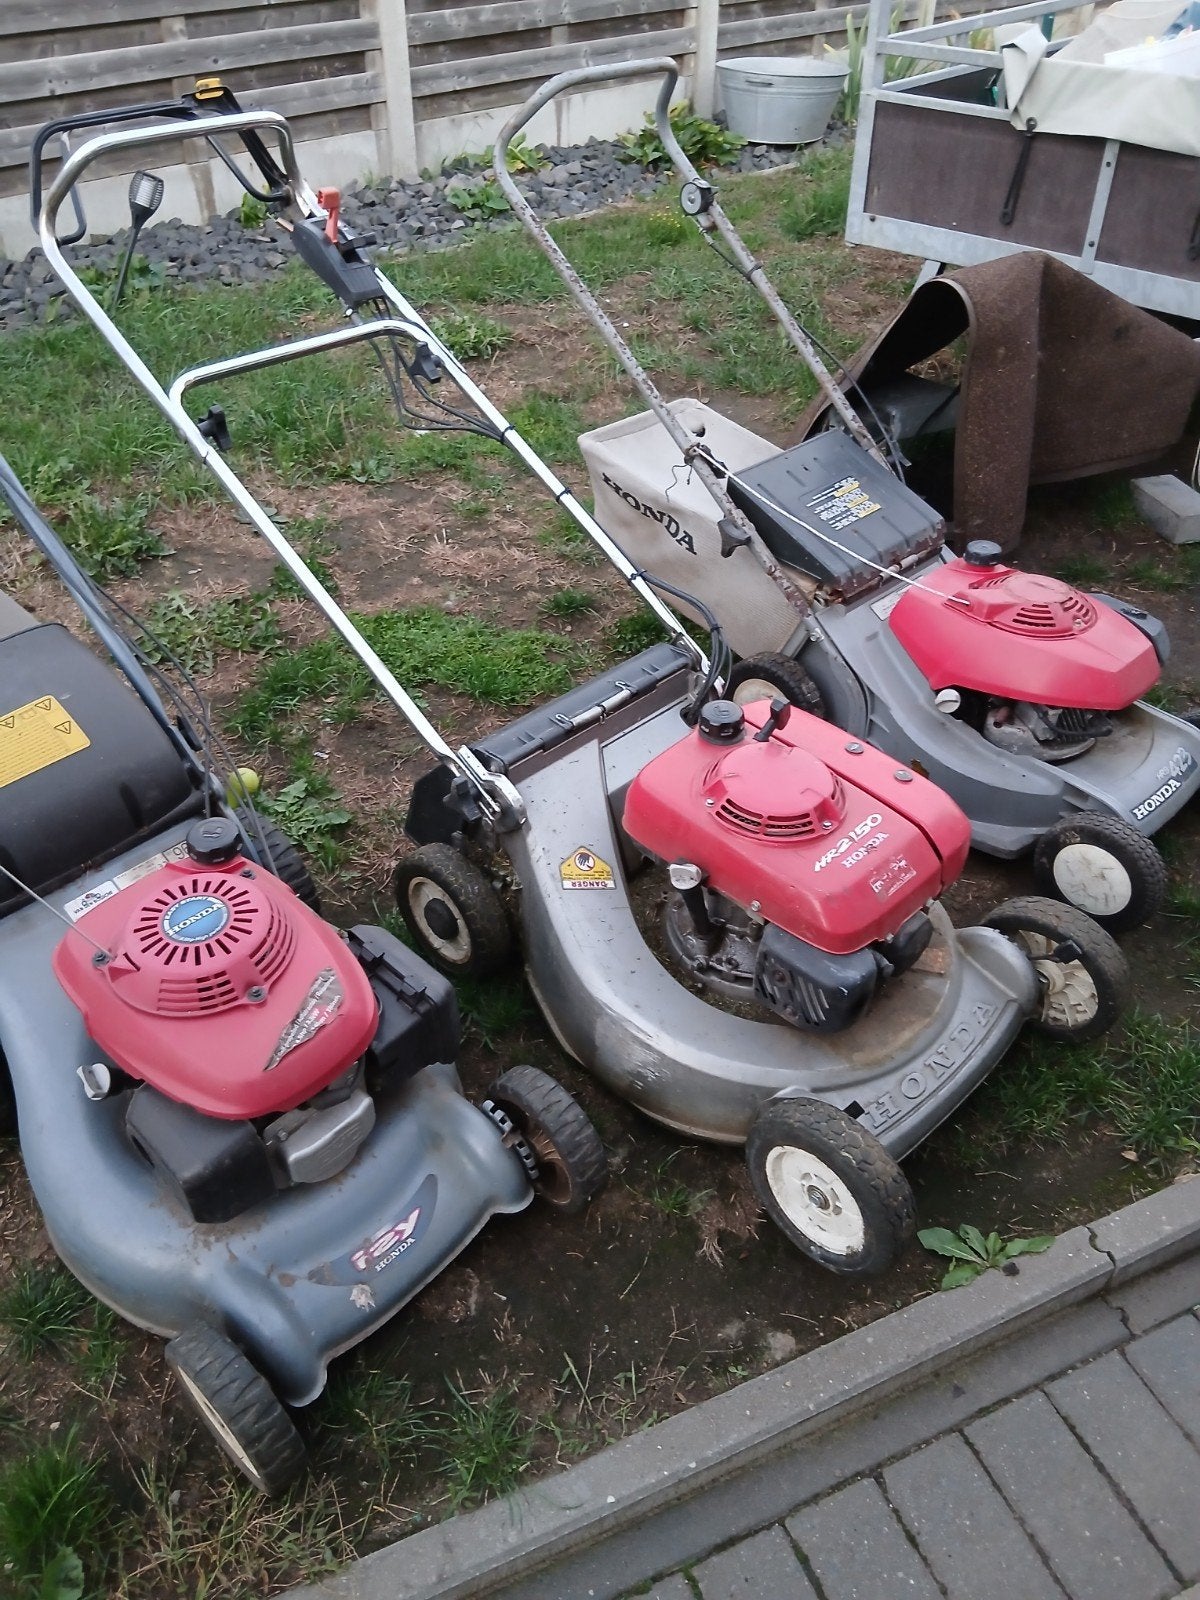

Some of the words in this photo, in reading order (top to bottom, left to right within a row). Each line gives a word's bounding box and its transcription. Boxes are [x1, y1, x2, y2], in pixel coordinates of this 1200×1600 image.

[602, 472, 697, 555] HONDA
[1132, 779, 1182, 820] HONDA
[814, 813, 883, 872] HR2150
[841, 832, 890, 868] HONDA
[166, 903, 226, 936] HONDA
[864, 1001, 998, 1130] HONDA
[375, 1237, 416, 1272] HONDA
